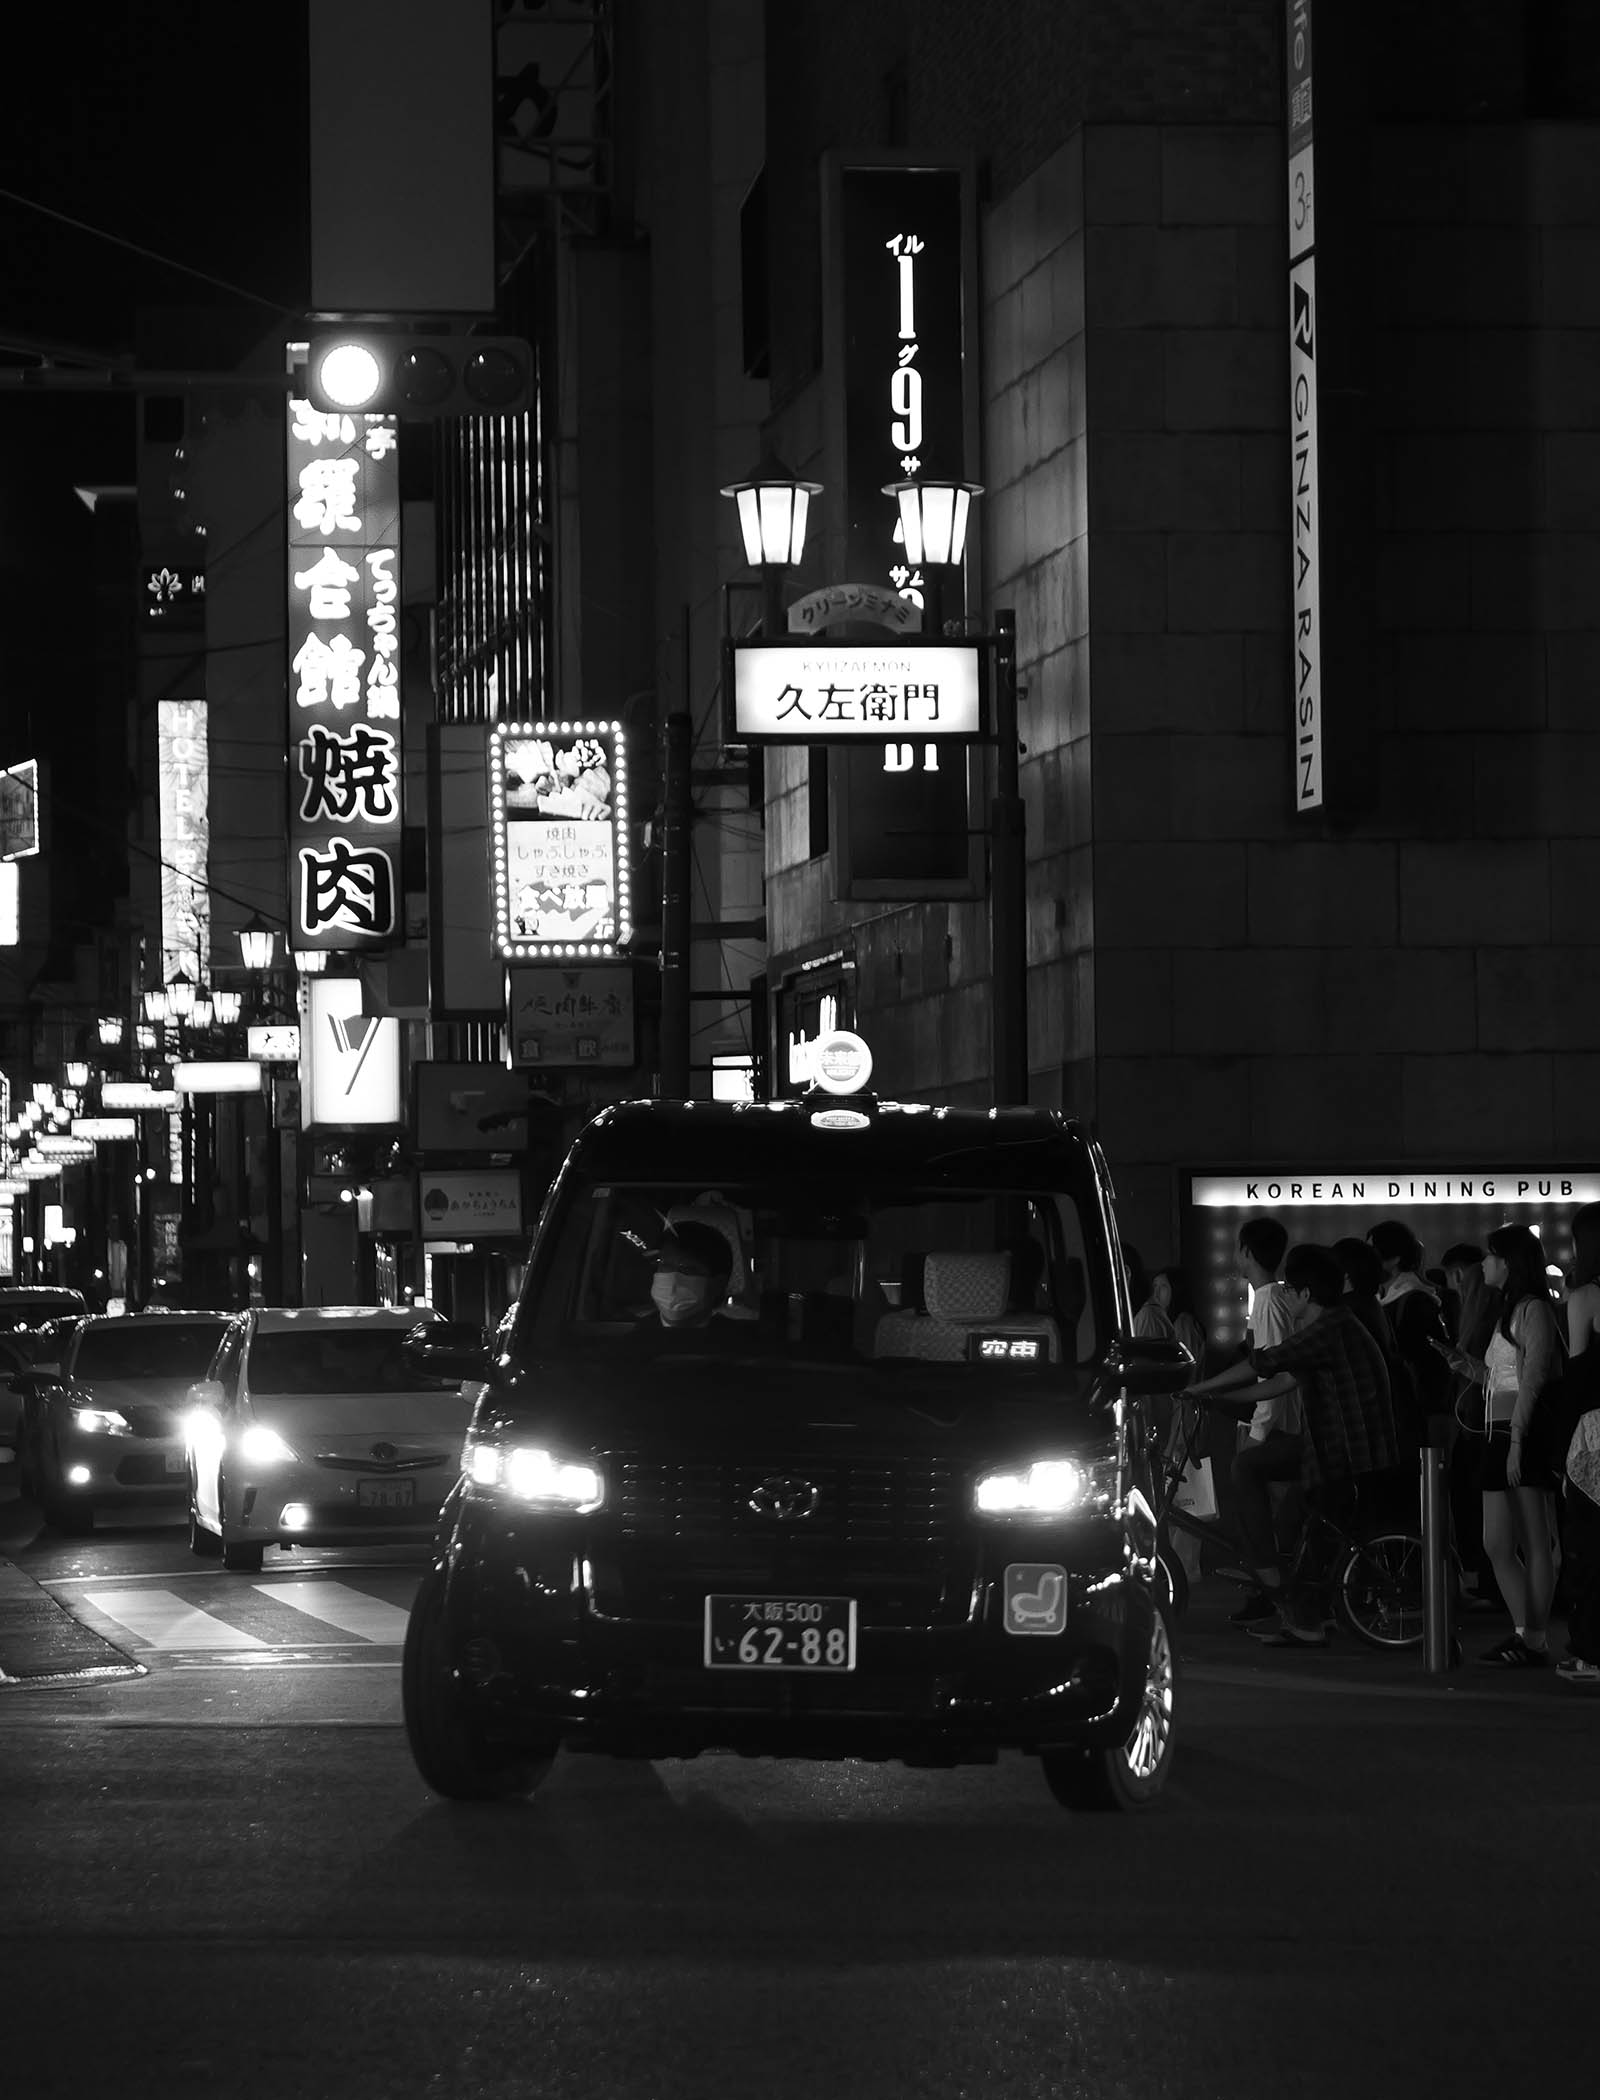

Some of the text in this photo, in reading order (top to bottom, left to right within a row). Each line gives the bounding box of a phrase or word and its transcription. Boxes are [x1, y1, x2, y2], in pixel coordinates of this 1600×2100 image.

[1294, 373, 1311, 591] GINZA
[801, 592, 911, 625] クリーンミナミ
[775, 682, 940, 722] 久左衛門
[1298, 607, 1315, 799] RASIN
[299, 724, 400, 935] 焼肉
[1246, 1179, 1575, 1199] KOREAN DINING PUB
[738, 1625, 846, 1666] 62-88
